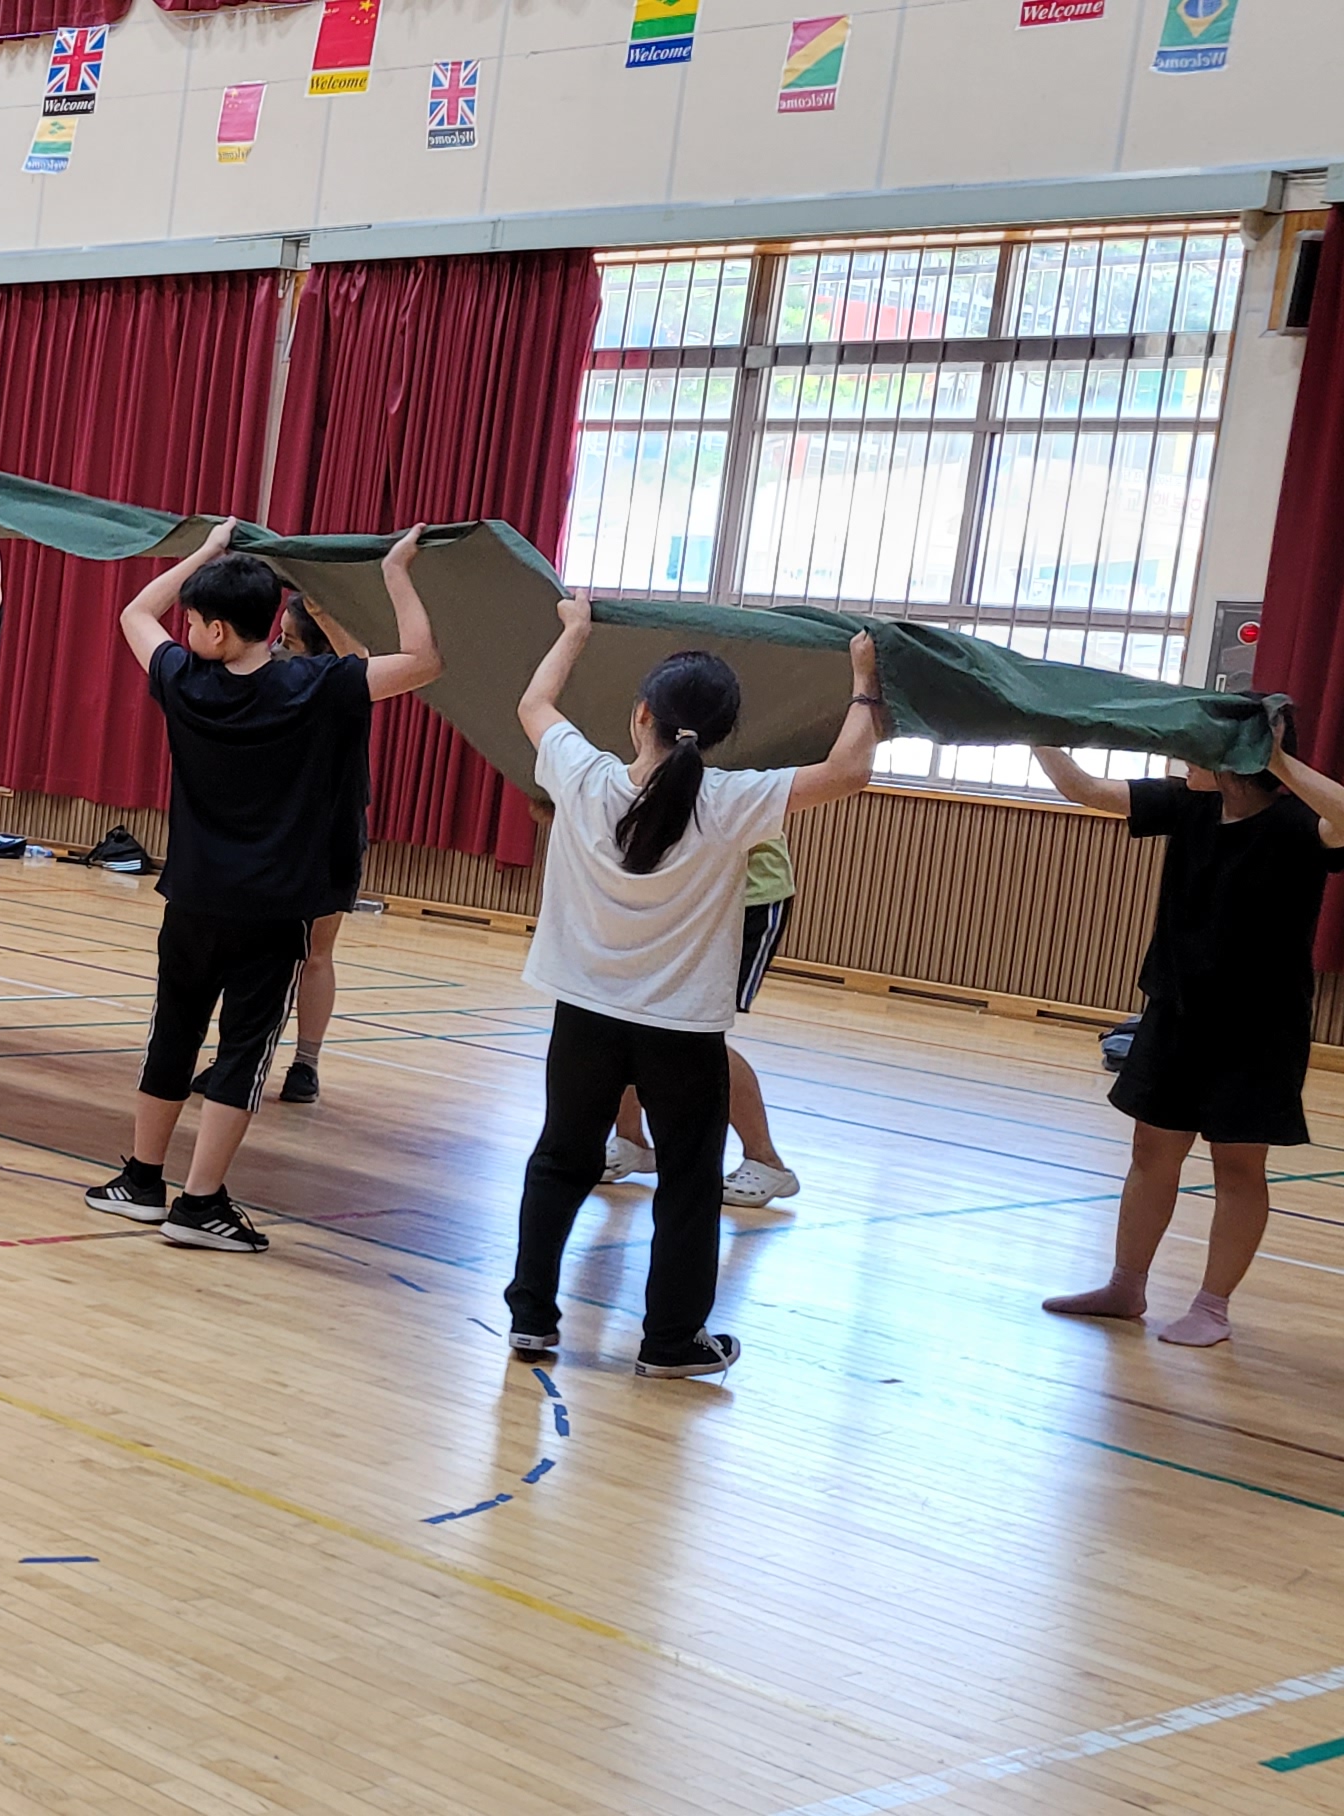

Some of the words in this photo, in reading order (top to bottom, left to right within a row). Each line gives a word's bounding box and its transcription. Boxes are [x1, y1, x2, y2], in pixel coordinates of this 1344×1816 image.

[1023, 0, 1103, 21] Welcome
[629, 45, 691, 64] Welcome
[310, 76, 368, 90] Welcome
[44, 98, 95, 113] Welcome
